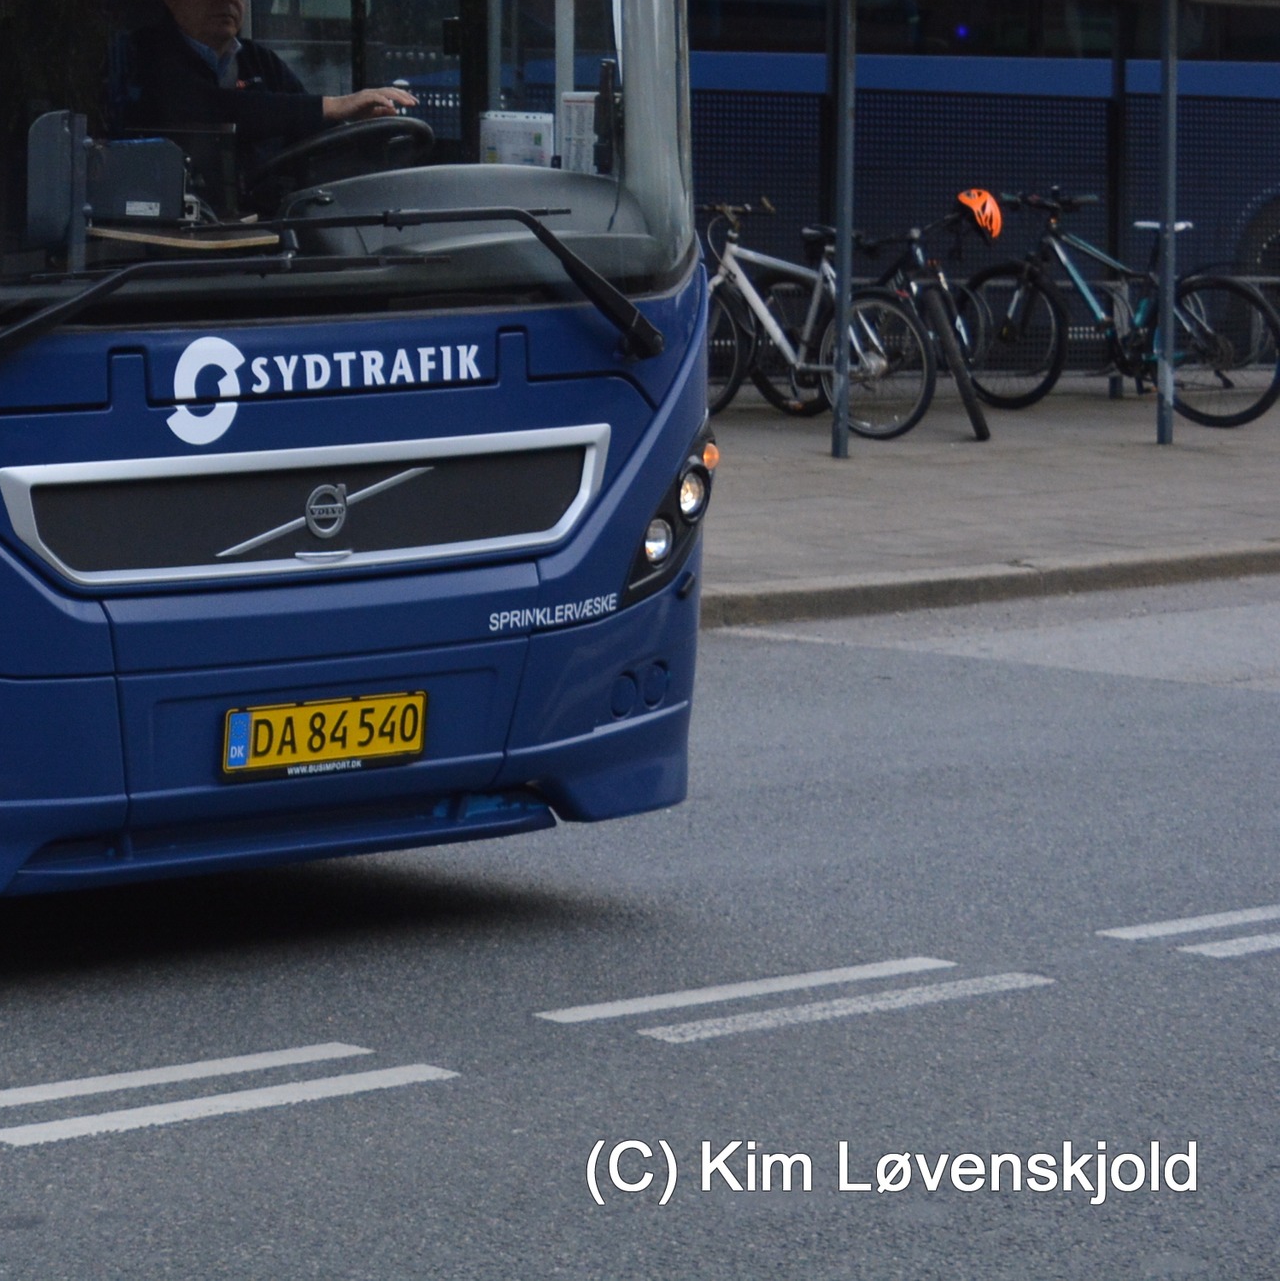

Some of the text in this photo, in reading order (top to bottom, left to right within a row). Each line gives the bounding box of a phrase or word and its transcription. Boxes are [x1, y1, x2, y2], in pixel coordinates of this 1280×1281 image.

[251, 345, 481, 394] SYDTRAFIK
[310, 506, 344, 518] VOLVO
[489, 593, 617, 631] SPRINKLERVÆSKE
[230, 745, 244, 759] DK
[252, 716, 297, 758] DA
[287, 759, 362, 776] WWW.BUSIMPORT.DK
